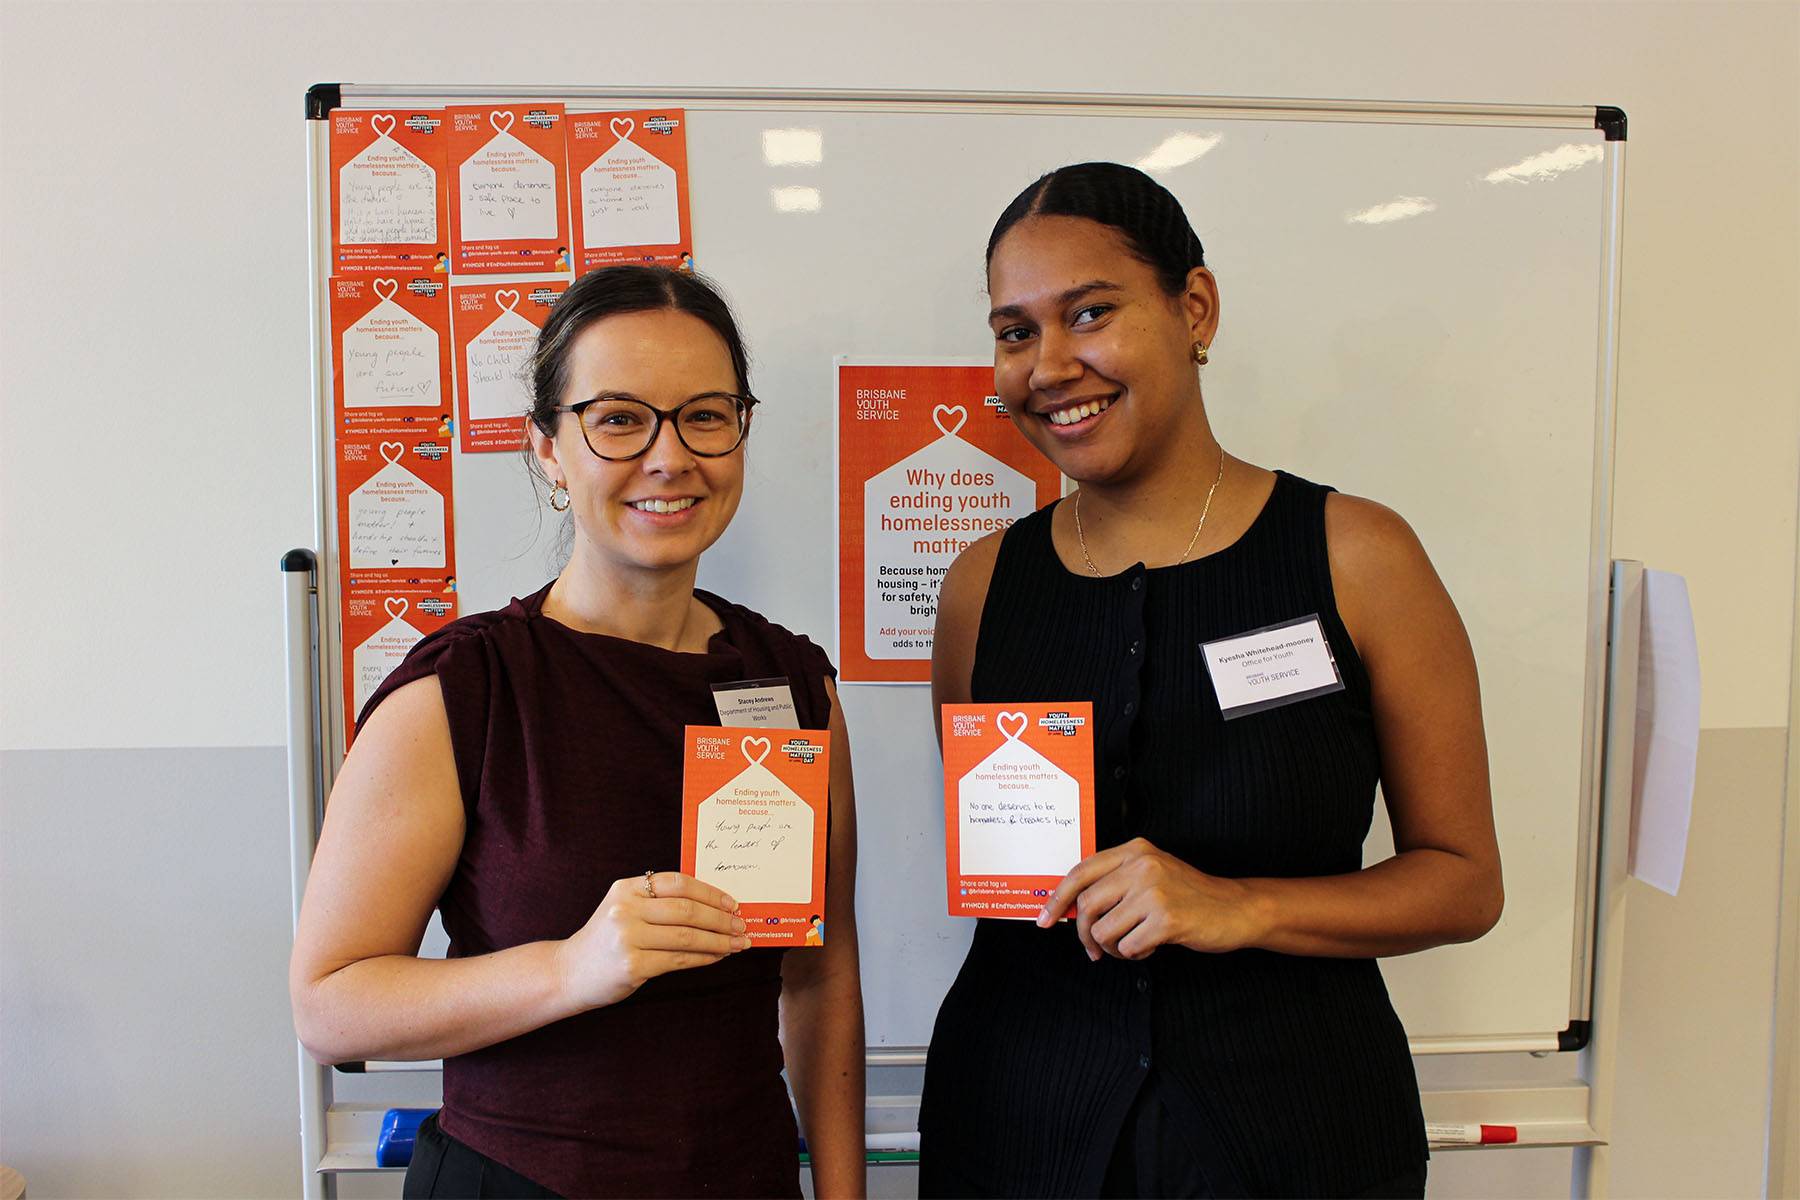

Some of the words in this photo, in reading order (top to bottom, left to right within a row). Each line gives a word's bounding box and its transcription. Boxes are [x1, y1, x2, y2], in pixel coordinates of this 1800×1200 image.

[856, 389, 906, 399] BRISBANE
[856, 400, 889, 409] YOUTH
[856, 410, 899, 420] SERVICE
[906, 469, 945, 490] Why
[950, 469, 994, 485] does
[890, 492, 952, 511] ending
[958, 492, 1010, 511] youth
[881, 514, 1014, 531] homelessness
[913, 538, 974, 554] matte
[879, 566, 923, 576] Because
[926, 566, 950, 576] hom
[877, 578, 918, 592] housing
[882, 592, 896, 602] for
[899, 592, 934, 604] safety,
[910, 604, 936, 617] brigh
[879, 628, 895, 636] Add
[898, 629, 917, 639] your
[893, 640, 913, 648] adds
[915, 640, 923, 648] to
[1219, 652, 1245, 664] Kyesha
[1246, 637, 1314, 657] Whitehead-mooney
[1242, 658, 1262, 668] Office
[1274, 651, 1294, 660] Youth
[1248, 677, 1270, 686] YOUTH
[1271, 668, 1300, 681] SERVICE
[738, 698, 754, 706] Stacey
[754, 696, 774, 704] Andrews
[696, 738, 730, 746] BRISBANE
[696, 752, 725, 760] SERVICE
[993, 764, 1018, 772] Ending
[734, 789, 758, 798] Ending
[760, 789, 780, 798] youth
[1034, 802, 1043, 810] to
[1046, 802, 1055, 811] be
